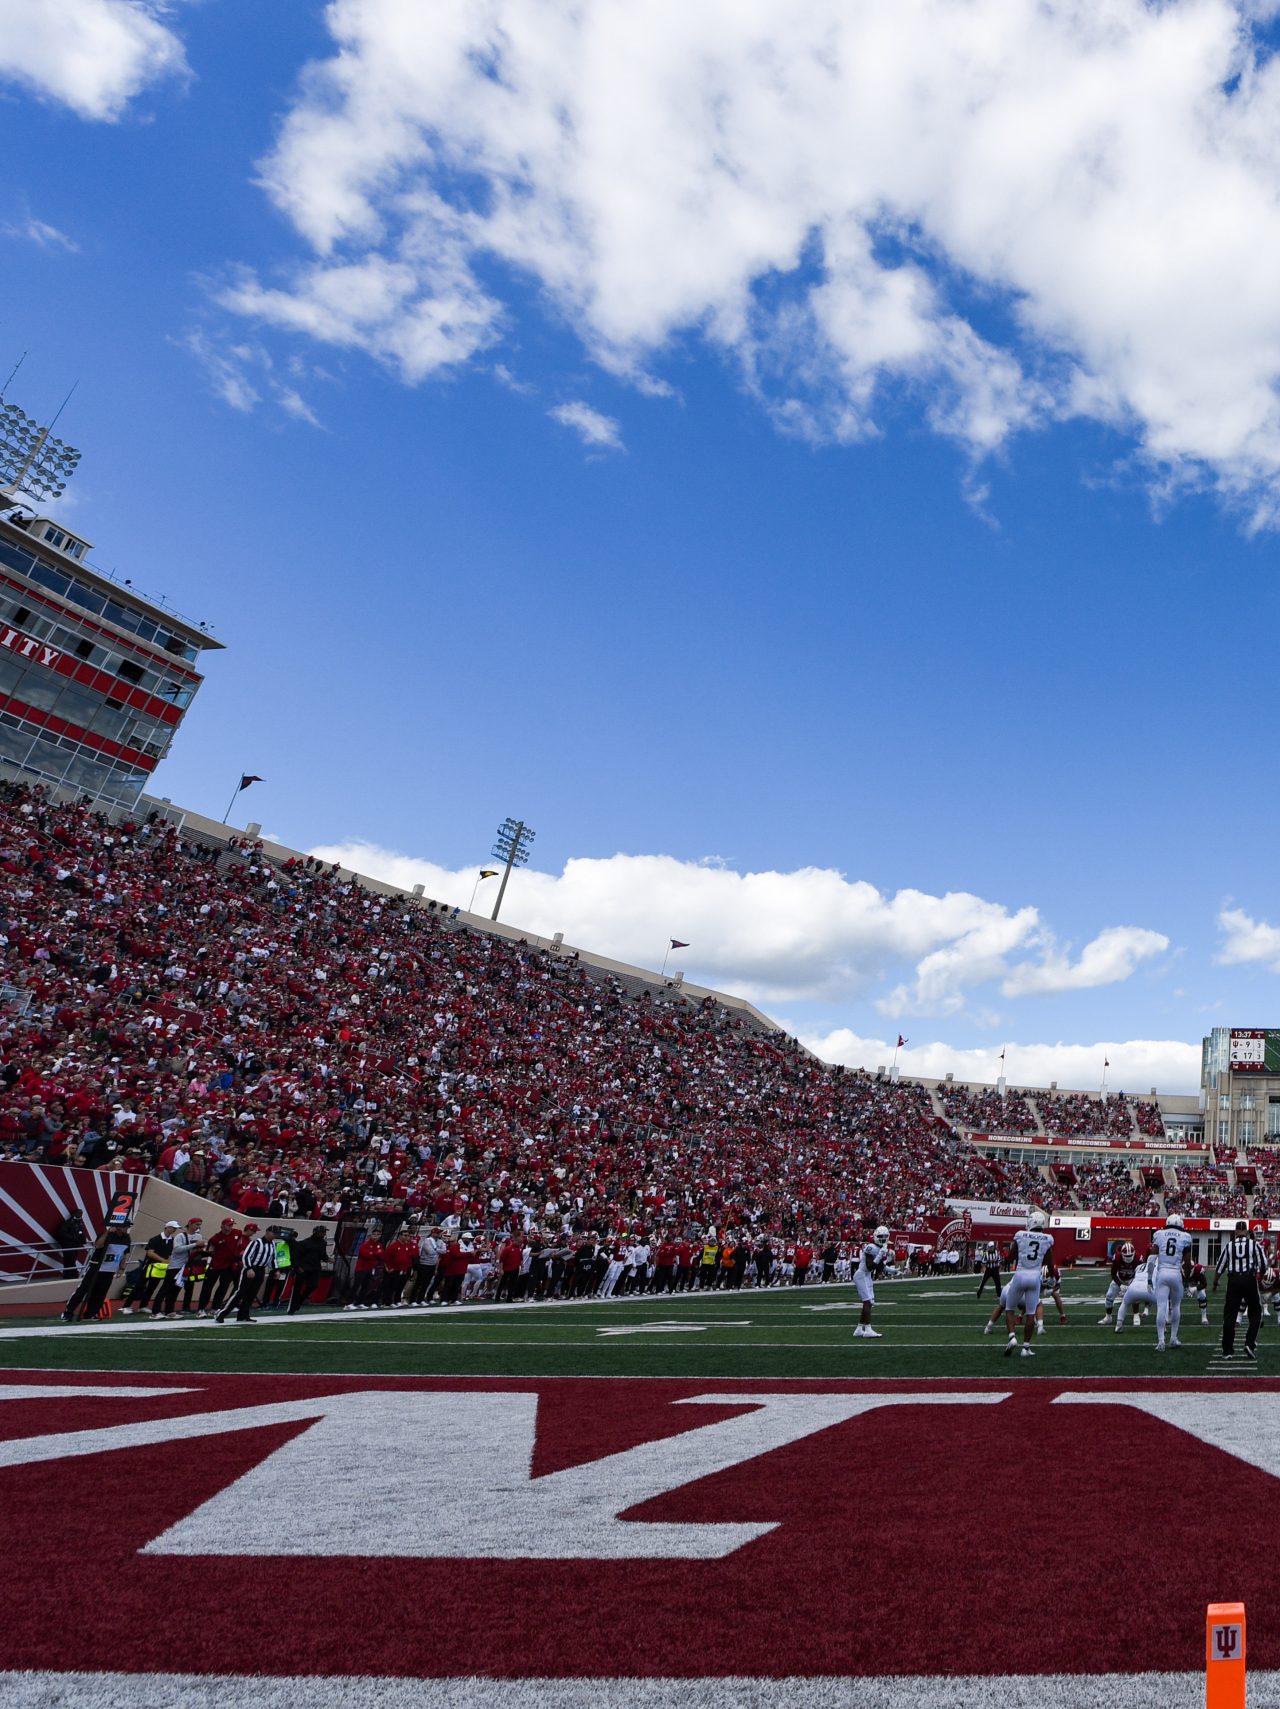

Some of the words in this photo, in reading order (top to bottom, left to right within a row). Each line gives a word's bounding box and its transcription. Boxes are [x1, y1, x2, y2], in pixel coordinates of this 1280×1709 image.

[10, 825, 29, 835] 107
[374, 1059, 382, 1067] 7
[988, 1135, 1032, 1143] HOMECOMING
[1068, 1139, 1111, 1147] HOMECOMING
[113, 1194, 133, 1213] 2
[997, 1206, 1012, 1215] Credit
[1012, 1207, 1027, 1216] Union
[1027, 1241, 1040, 1260] 3
[1165, 1238, 1177, 1256] 6
[1235, 1243, 1246, 1258] U
